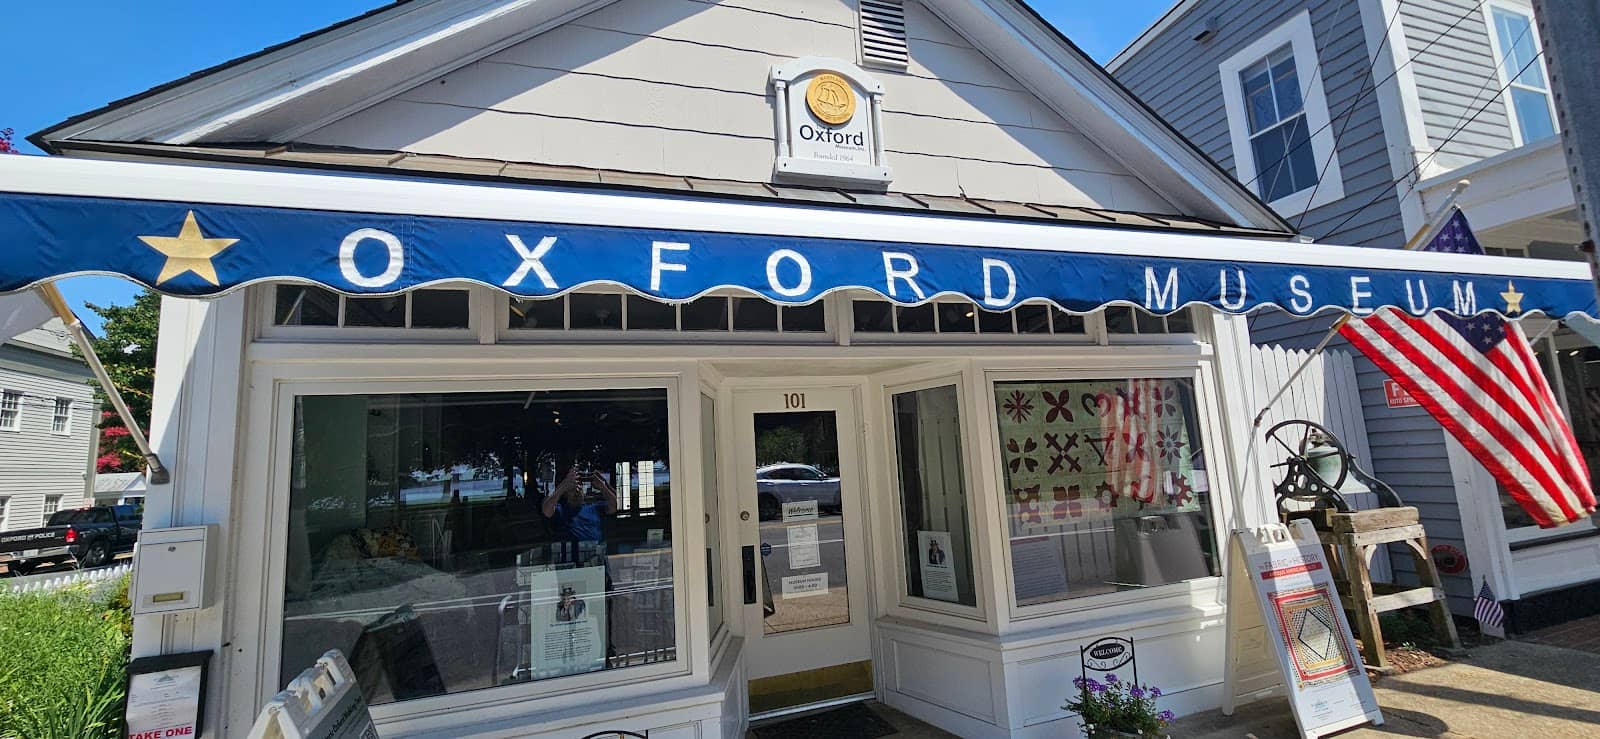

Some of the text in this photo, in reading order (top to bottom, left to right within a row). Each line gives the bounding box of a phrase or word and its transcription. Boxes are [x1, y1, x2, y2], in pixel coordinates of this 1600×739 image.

[799, 124, 864, 147] Oxford
[814, 151, 838, 161] Founded
[339, 227, 1477, 316] OXFORD MUSEUM
[783, 392, 806, 409] 101
[1, 535, 27, 543] OXFORD
[35, 532, 56, 540] POLICE
[1093, 646, 1123, 657] WELCOME
[128, 726, 193, 739] TAKE ONE
